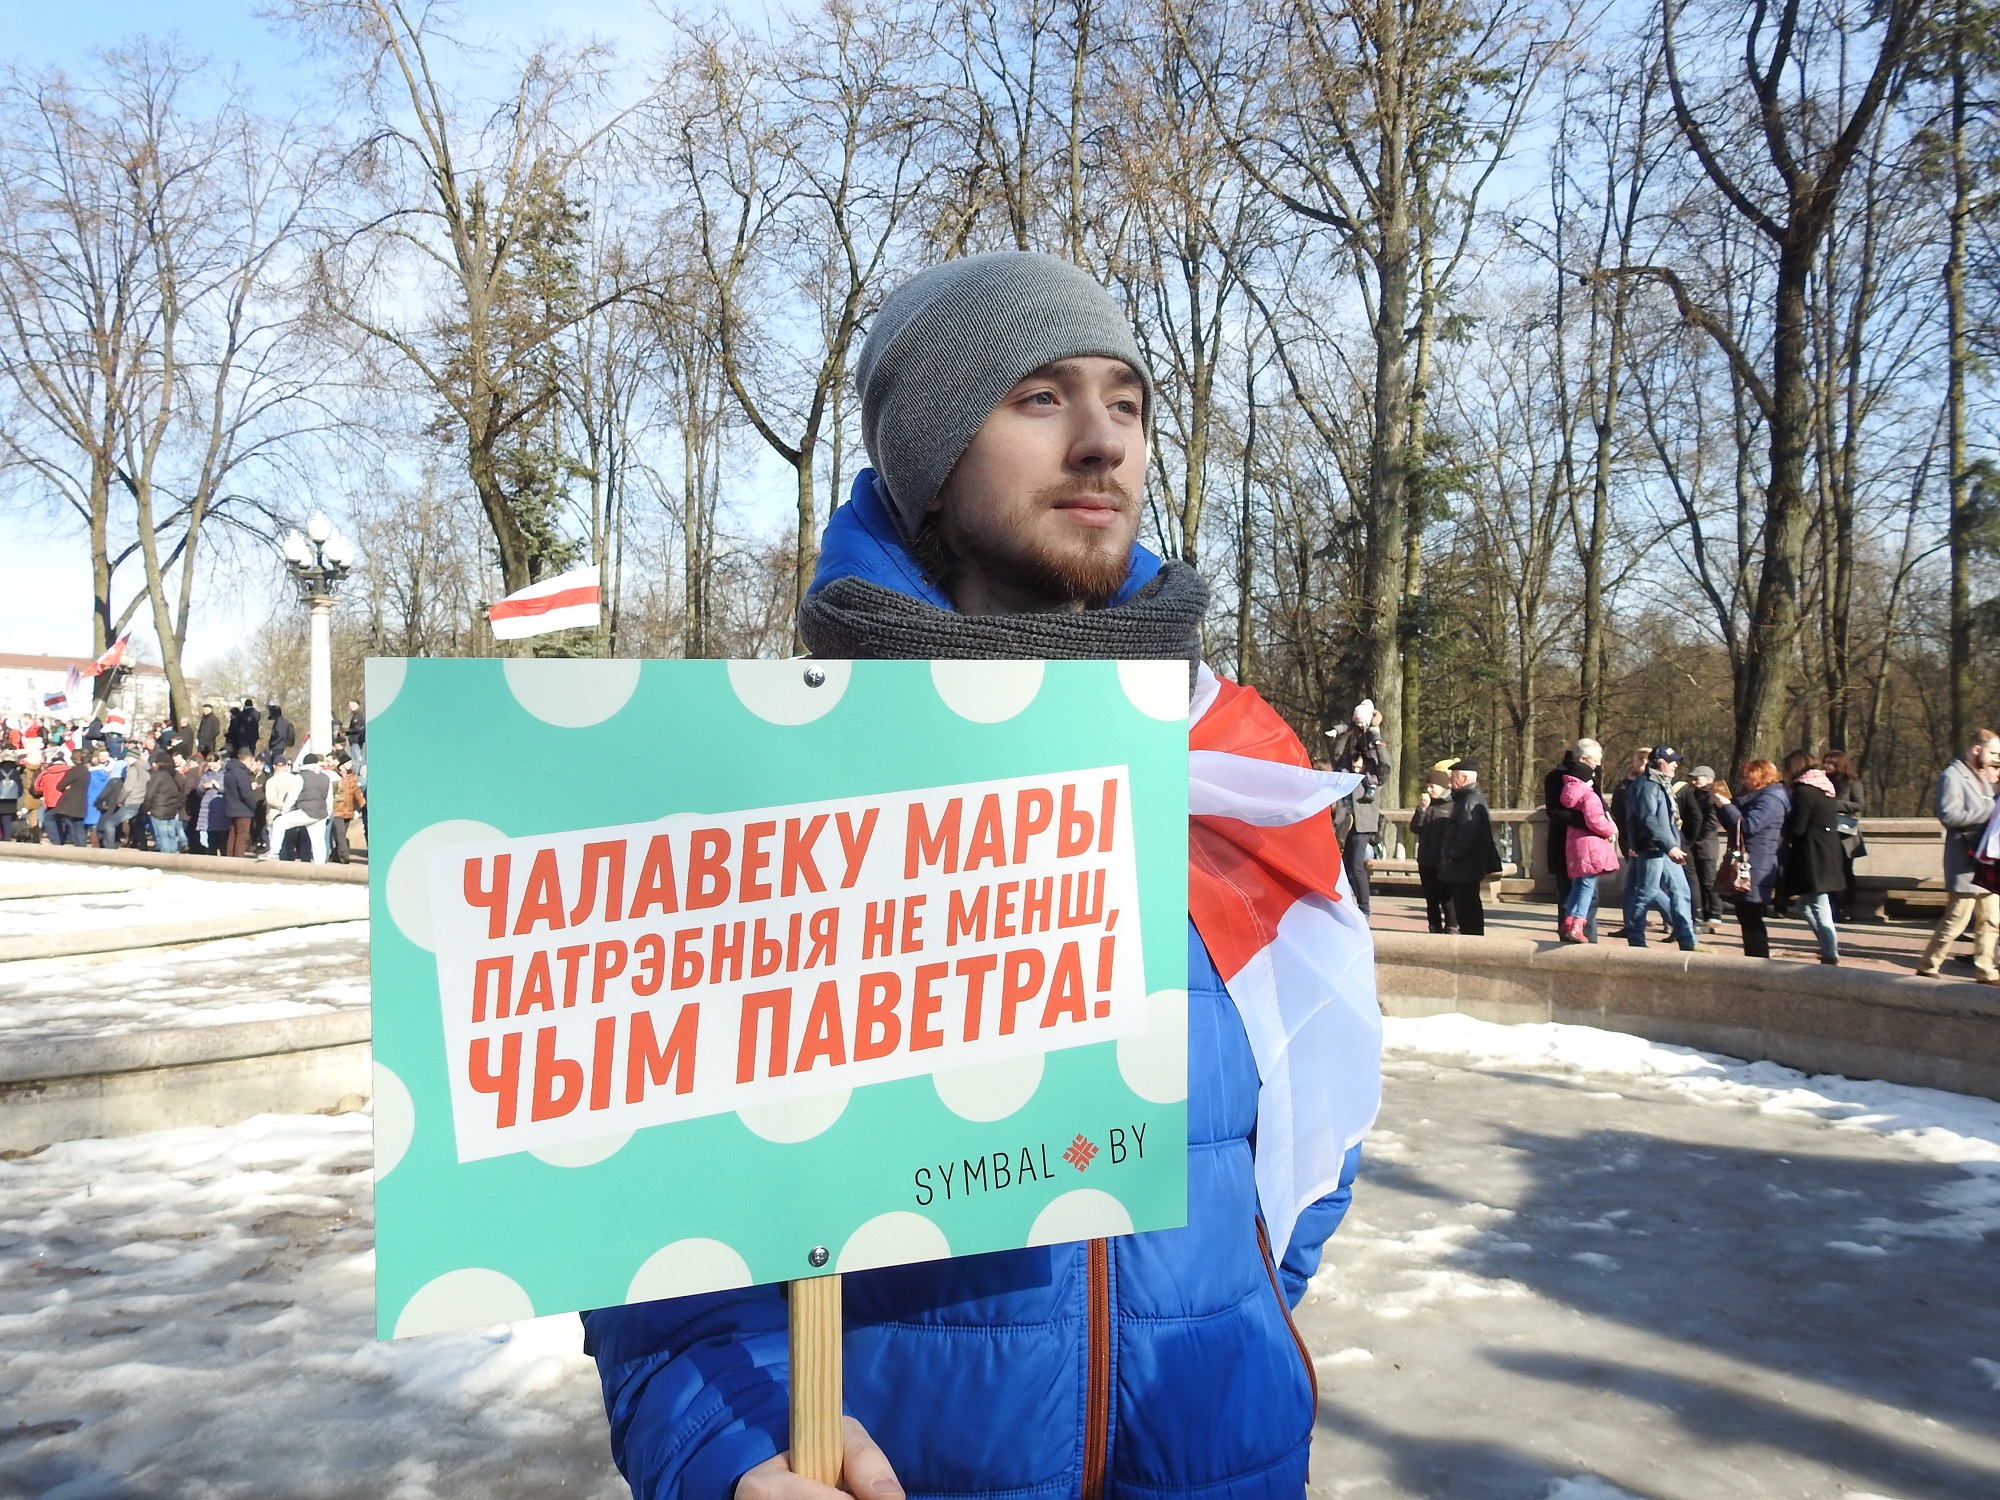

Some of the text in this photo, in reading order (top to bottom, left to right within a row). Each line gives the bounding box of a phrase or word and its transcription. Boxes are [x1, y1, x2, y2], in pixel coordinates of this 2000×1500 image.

[463, 778, 1118, 939] ЧАЛАВЕКУ МАРЫ
[471, 868, 1120, 1023] ПАТРЭБНЫЯ НЕ МЕНШ,
[468, 935, 1116, 1129] ЧЫМ ПАВЕТРА!
[914, 1122, 1147, 1206] SYMBAL BY
